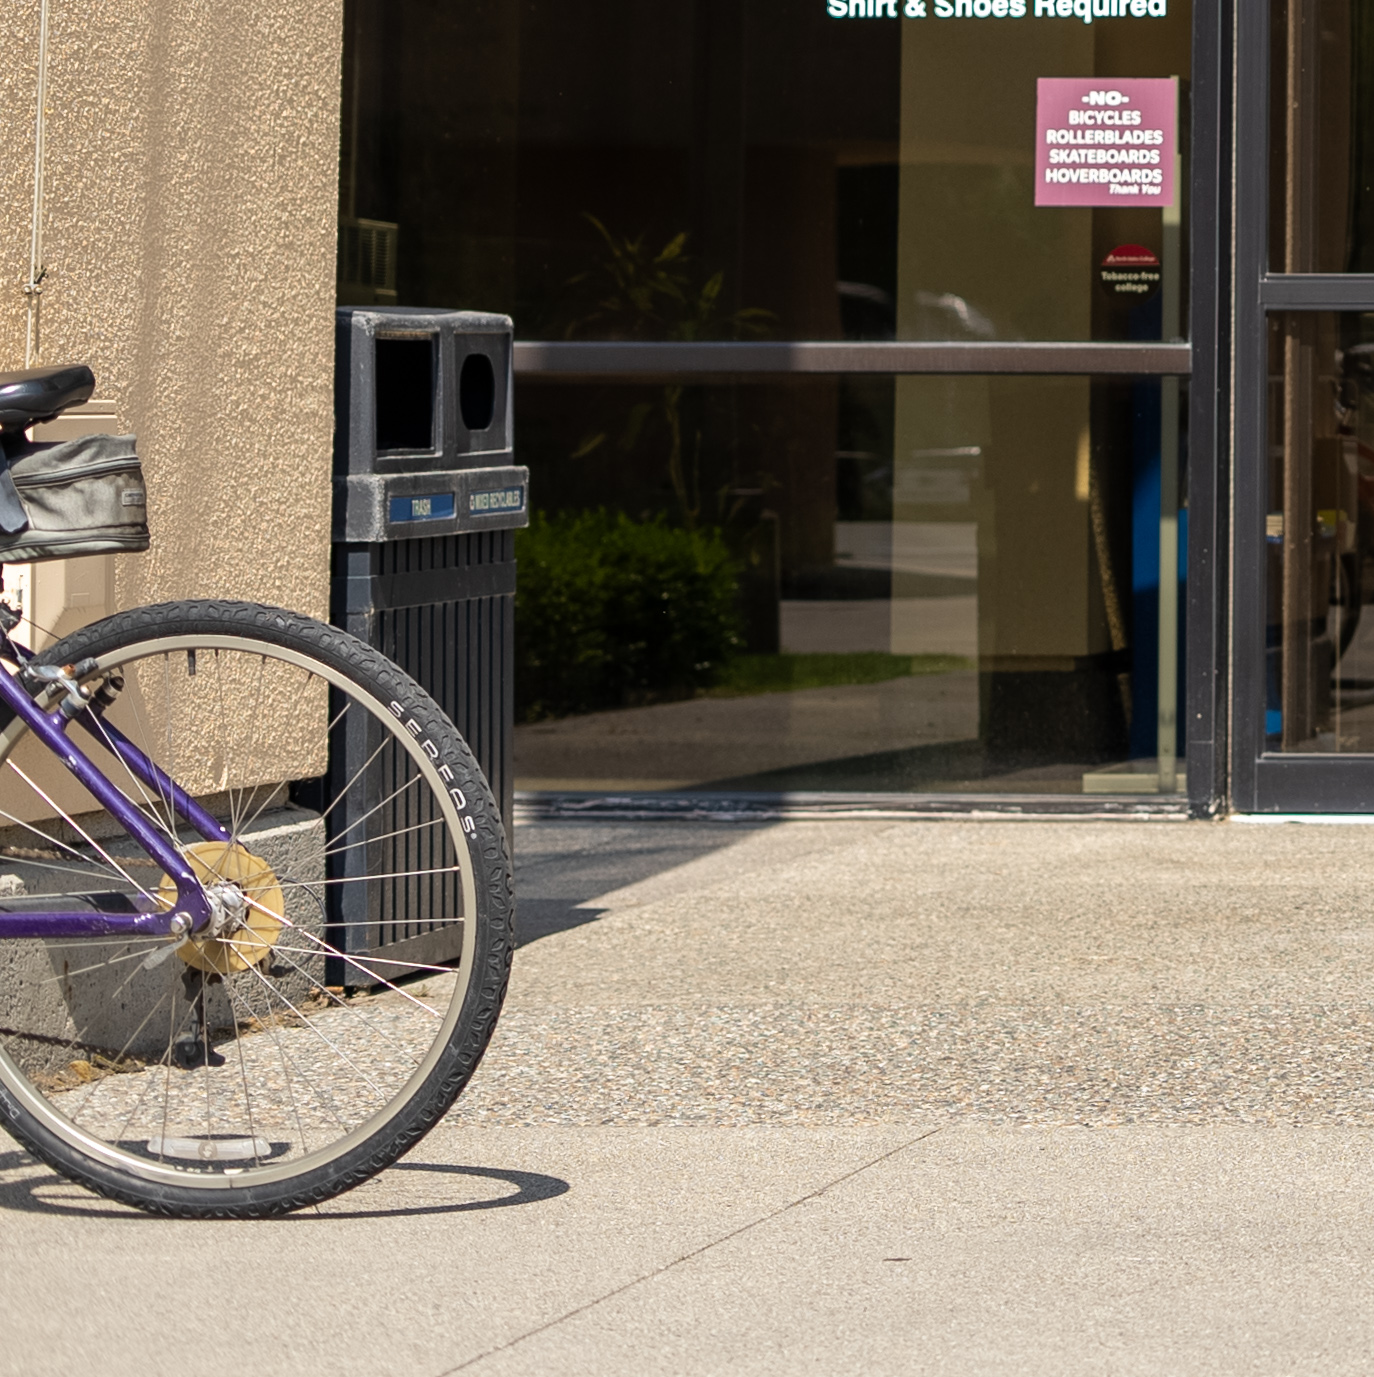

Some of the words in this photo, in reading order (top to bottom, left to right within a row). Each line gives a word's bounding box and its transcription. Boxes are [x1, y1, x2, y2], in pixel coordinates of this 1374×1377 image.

[1068, 110, 1142, 125] BICYCLES
[1046, 129, 1164, 145] ROLLERBLADES
[1049, 149, 1161, 164] SKATEBOARDS
[1045, 168, 1163, 184] HOVERBOARDS
[1109, 184, 1139, 195] Thank
[1141, 184, 1162, 195] You
[1101, 271, 1160, 281] Tobacco-free
[1115, 282, 1149, 294] college
[411, 498, 432, 517] TRASH
[388, 700, 477, 834] SERFAS
